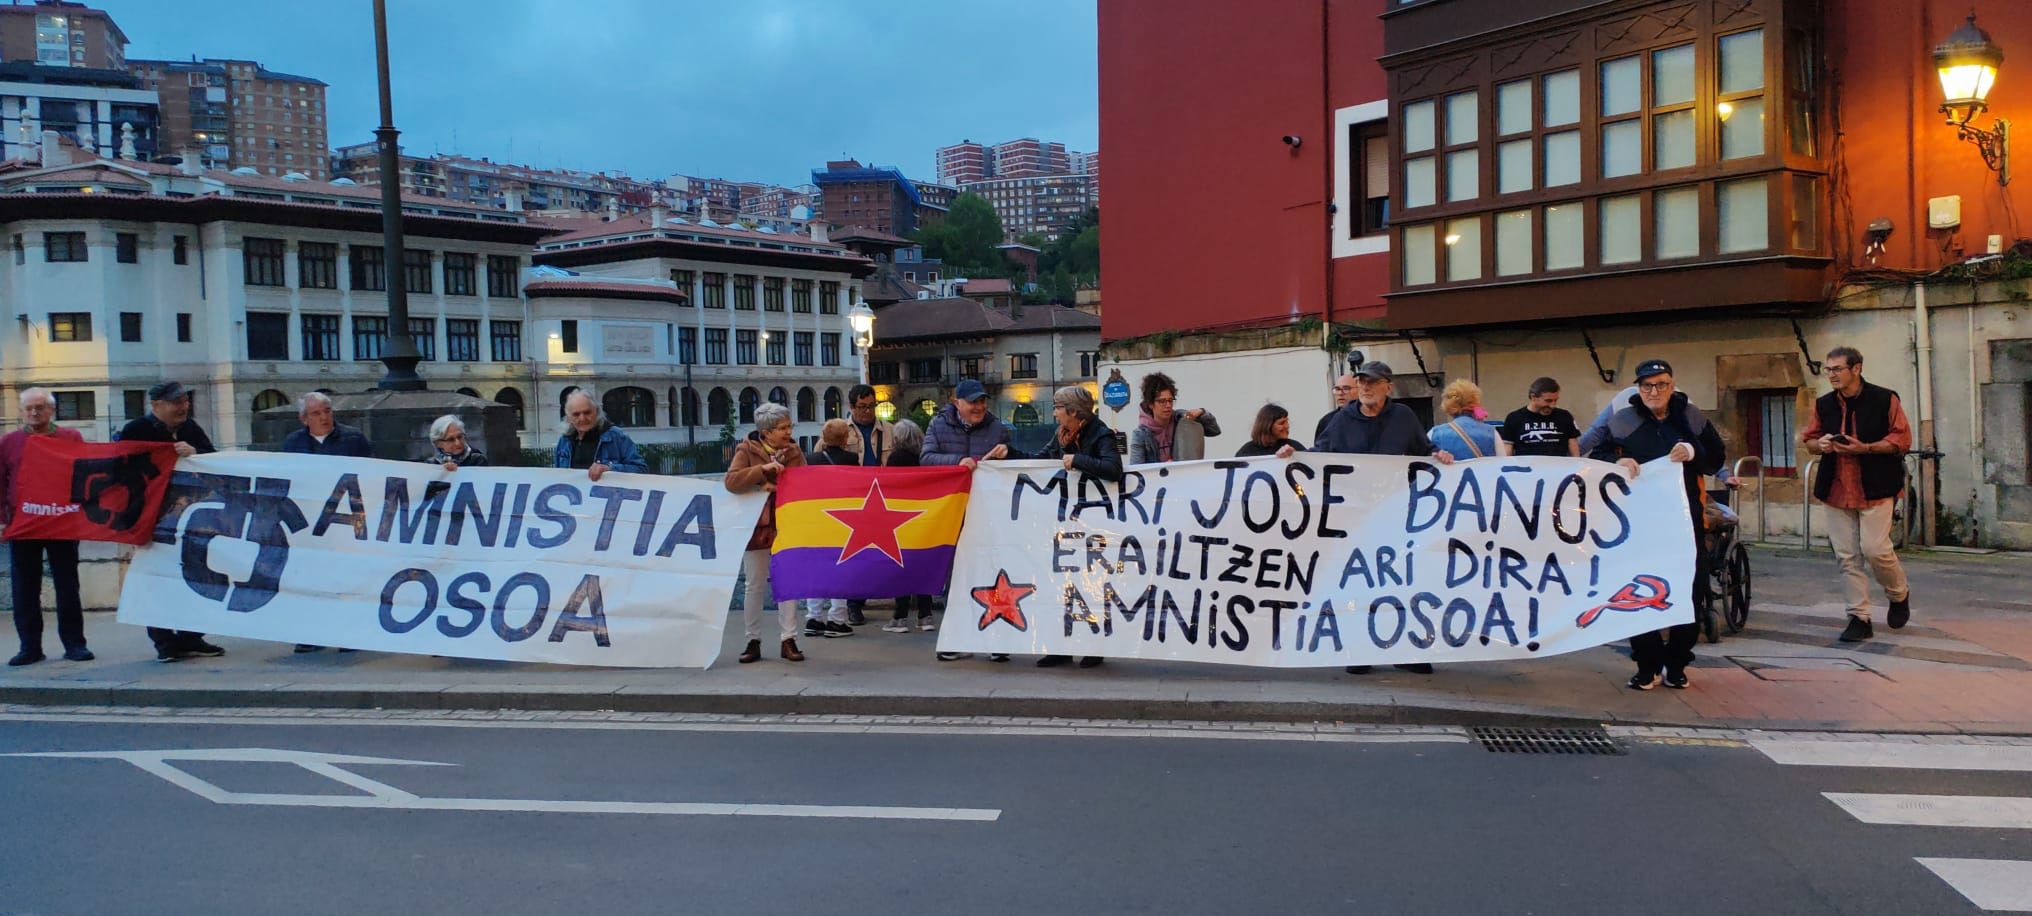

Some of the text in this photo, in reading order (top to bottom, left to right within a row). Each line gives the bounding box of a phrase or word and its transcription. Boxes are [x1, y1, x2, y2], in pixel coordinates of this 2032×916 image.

[312, 473, 717, 560] AMNISTIA
[1190, 460, 1354, 540] JOSE
[1405, 460, 1631, 549] BAÑOS
[378, 568, 611, 647] OSOA
[1368, 591, 1541, 651] OSOA!
